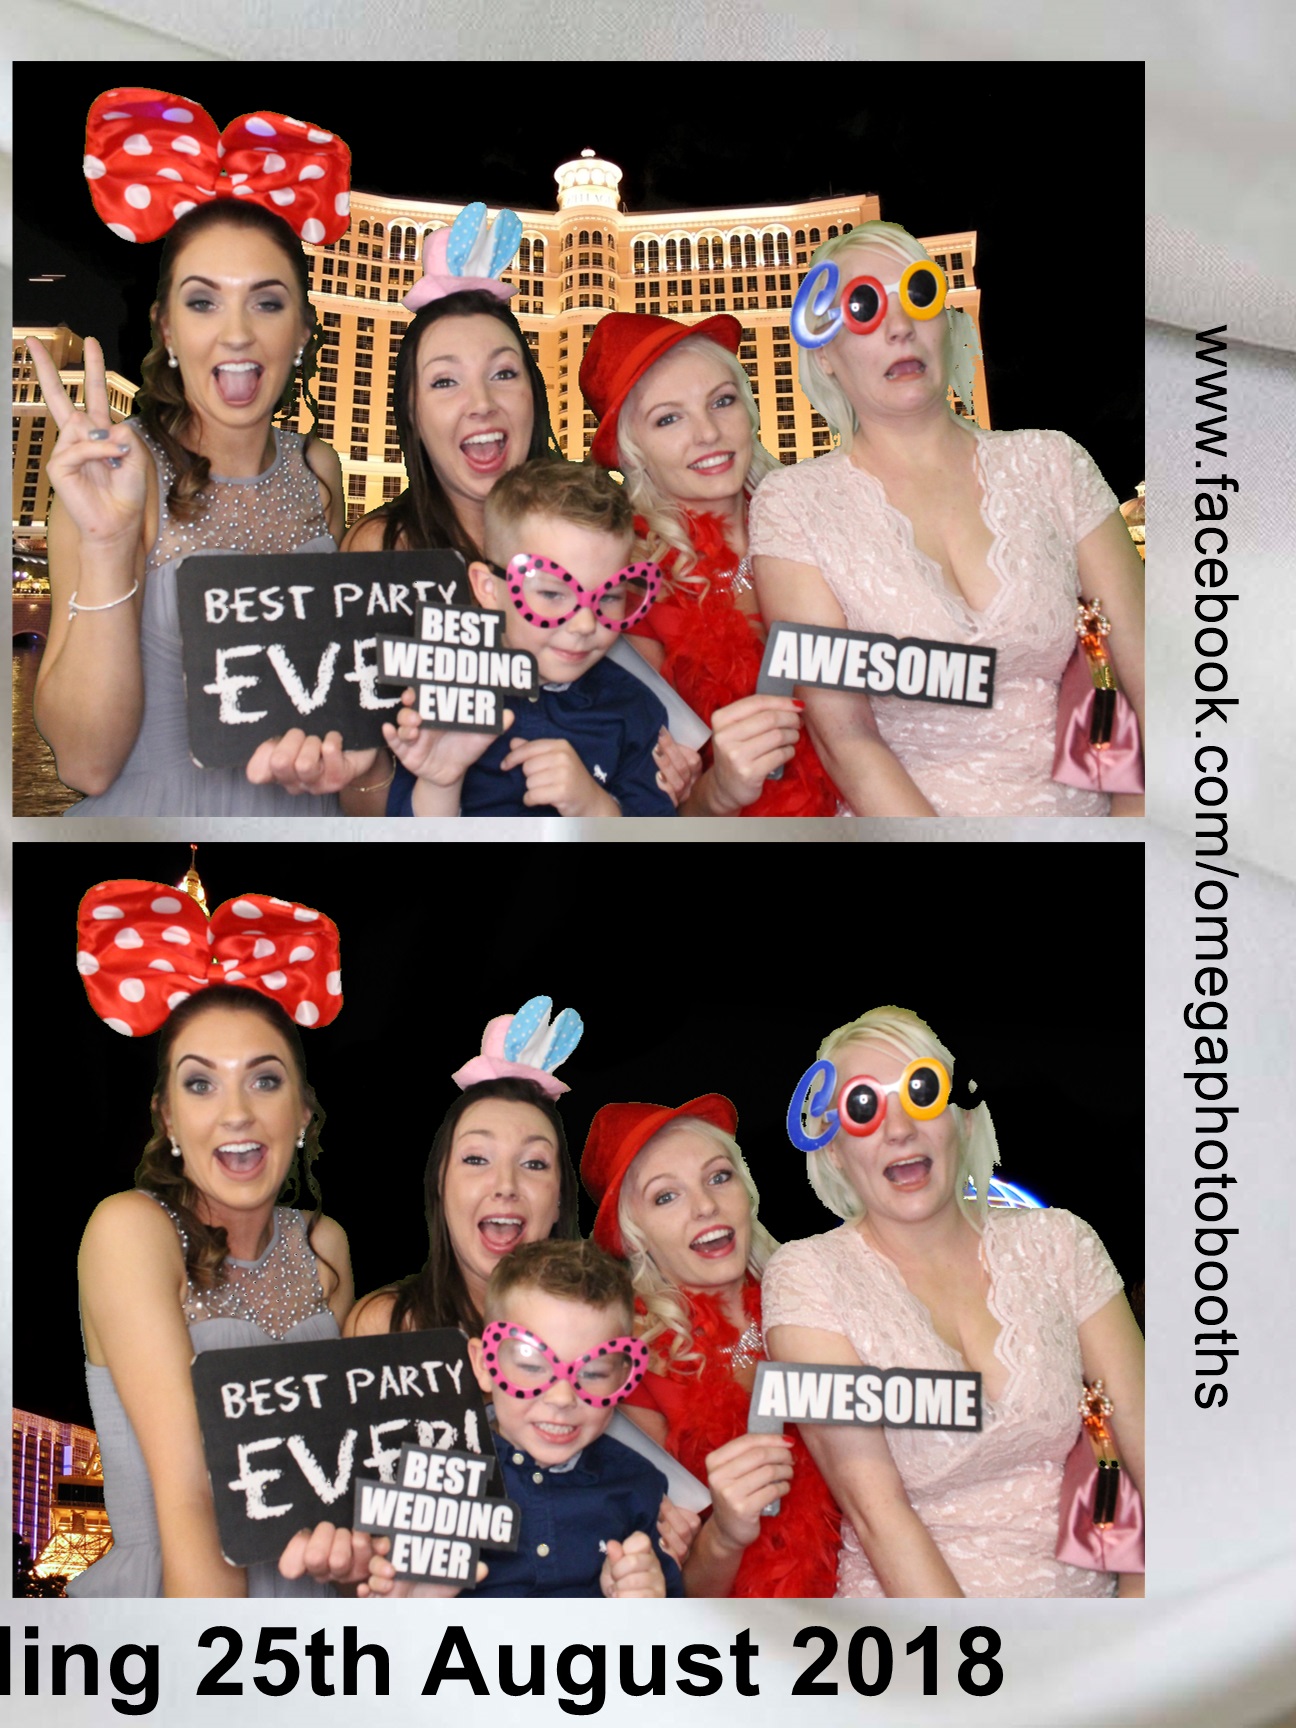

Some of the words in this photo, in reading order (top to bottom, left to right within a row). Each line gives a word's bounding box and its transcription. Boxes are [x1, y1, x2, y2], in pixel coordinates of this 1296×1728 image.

[204, 584, 315, 624] BEST
[333, 580, 457, 618] PARTY
[421, 607, 500, 648] BEST
[204, 636, 403, 725] EVE
[382, 640, 533, 690] WEDDING
[767, 631, 991, 703] AWESOME
[418, 685, 496, 727] EVER
[221, 1374, 329, 1419] BEST
[345, 1358, 463, 1404] PARTY
[757, 1370, 977, 1426] AWESOME
[403, 1450, 487, 1497] BEST
[360, 1486, 514, 1543] WEDDING
[391, 1533, 473, 1581] EVER
